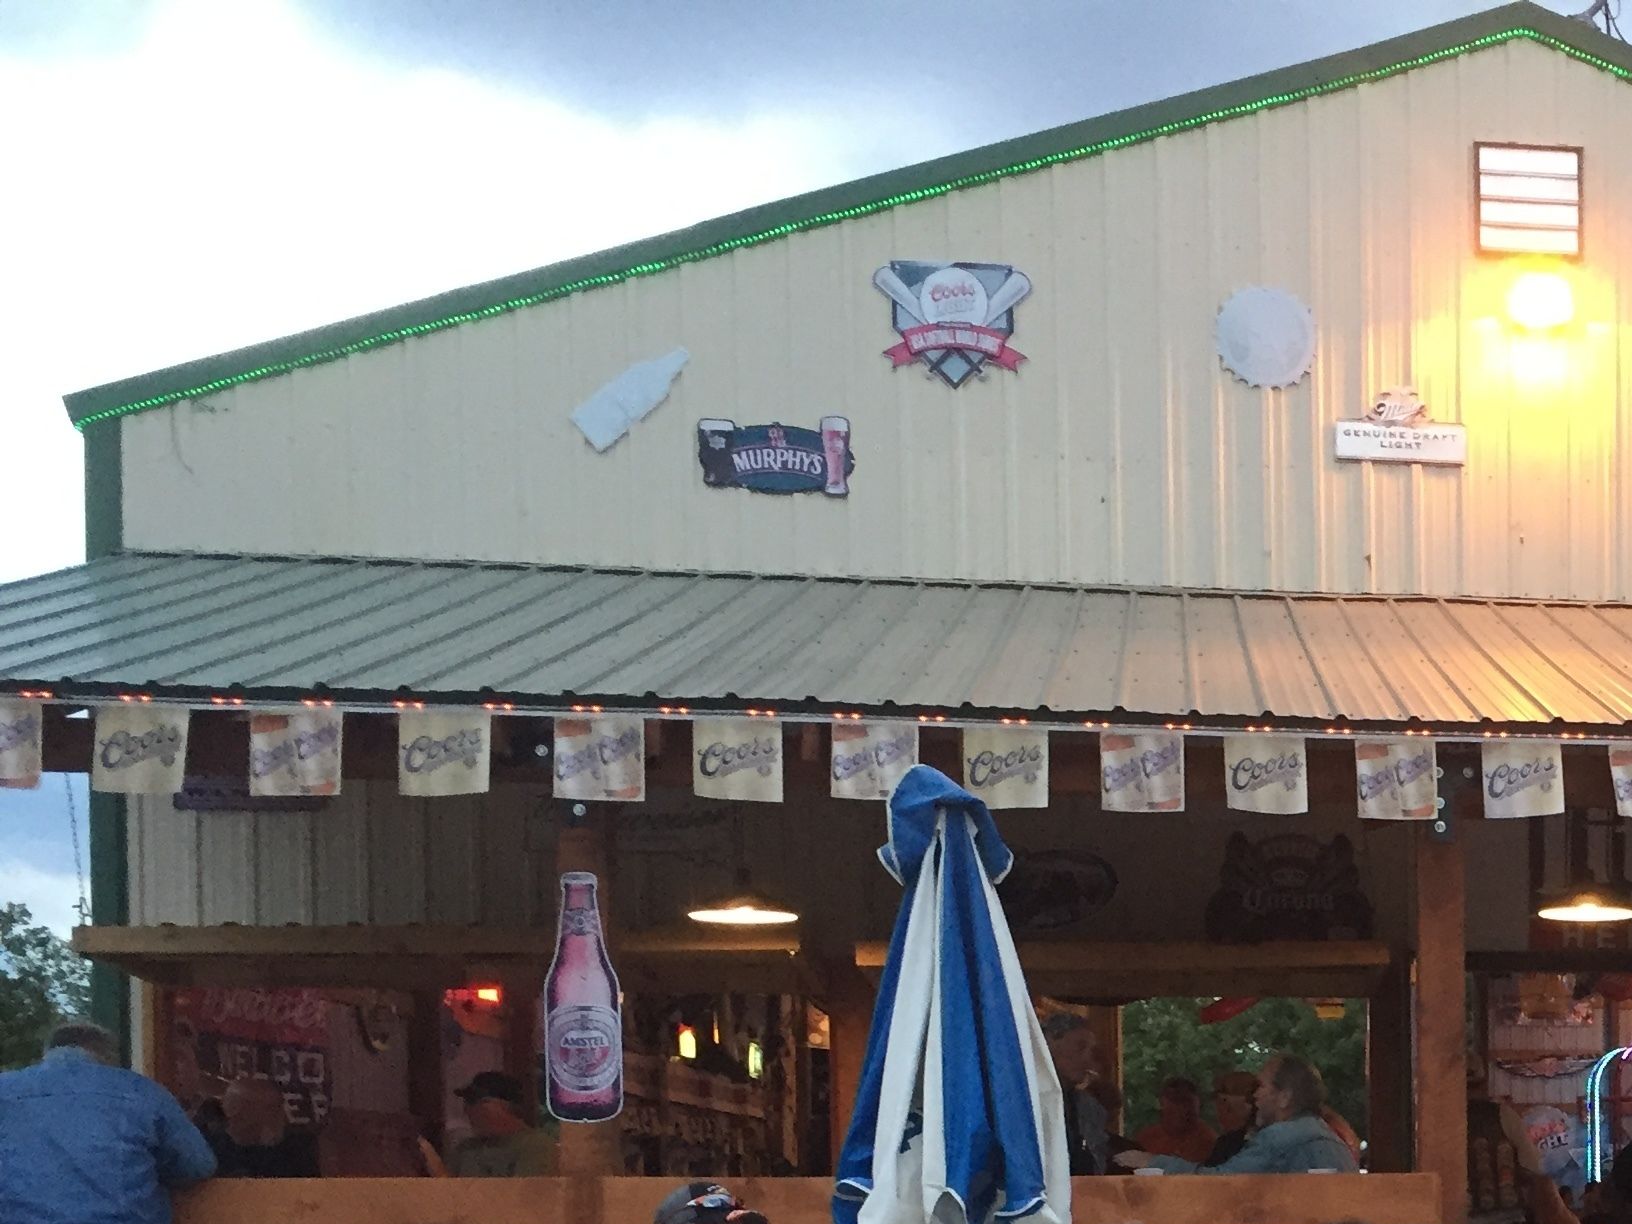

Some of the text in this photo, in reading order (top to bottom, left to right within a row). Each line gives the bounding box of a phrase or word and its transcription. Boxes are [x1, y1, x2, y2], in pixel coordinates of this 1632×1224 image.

[1343, 428, 1458, 442] GENUINE DRAFT
[1379, 440, 1422, 450] LIGHT
[698, 736, 778, 778] Coors
[967, 745, 1043, 788] Coors
[1229, 752, 1301, 791] Coors
[1485, 757, 1556, 799] Coors
